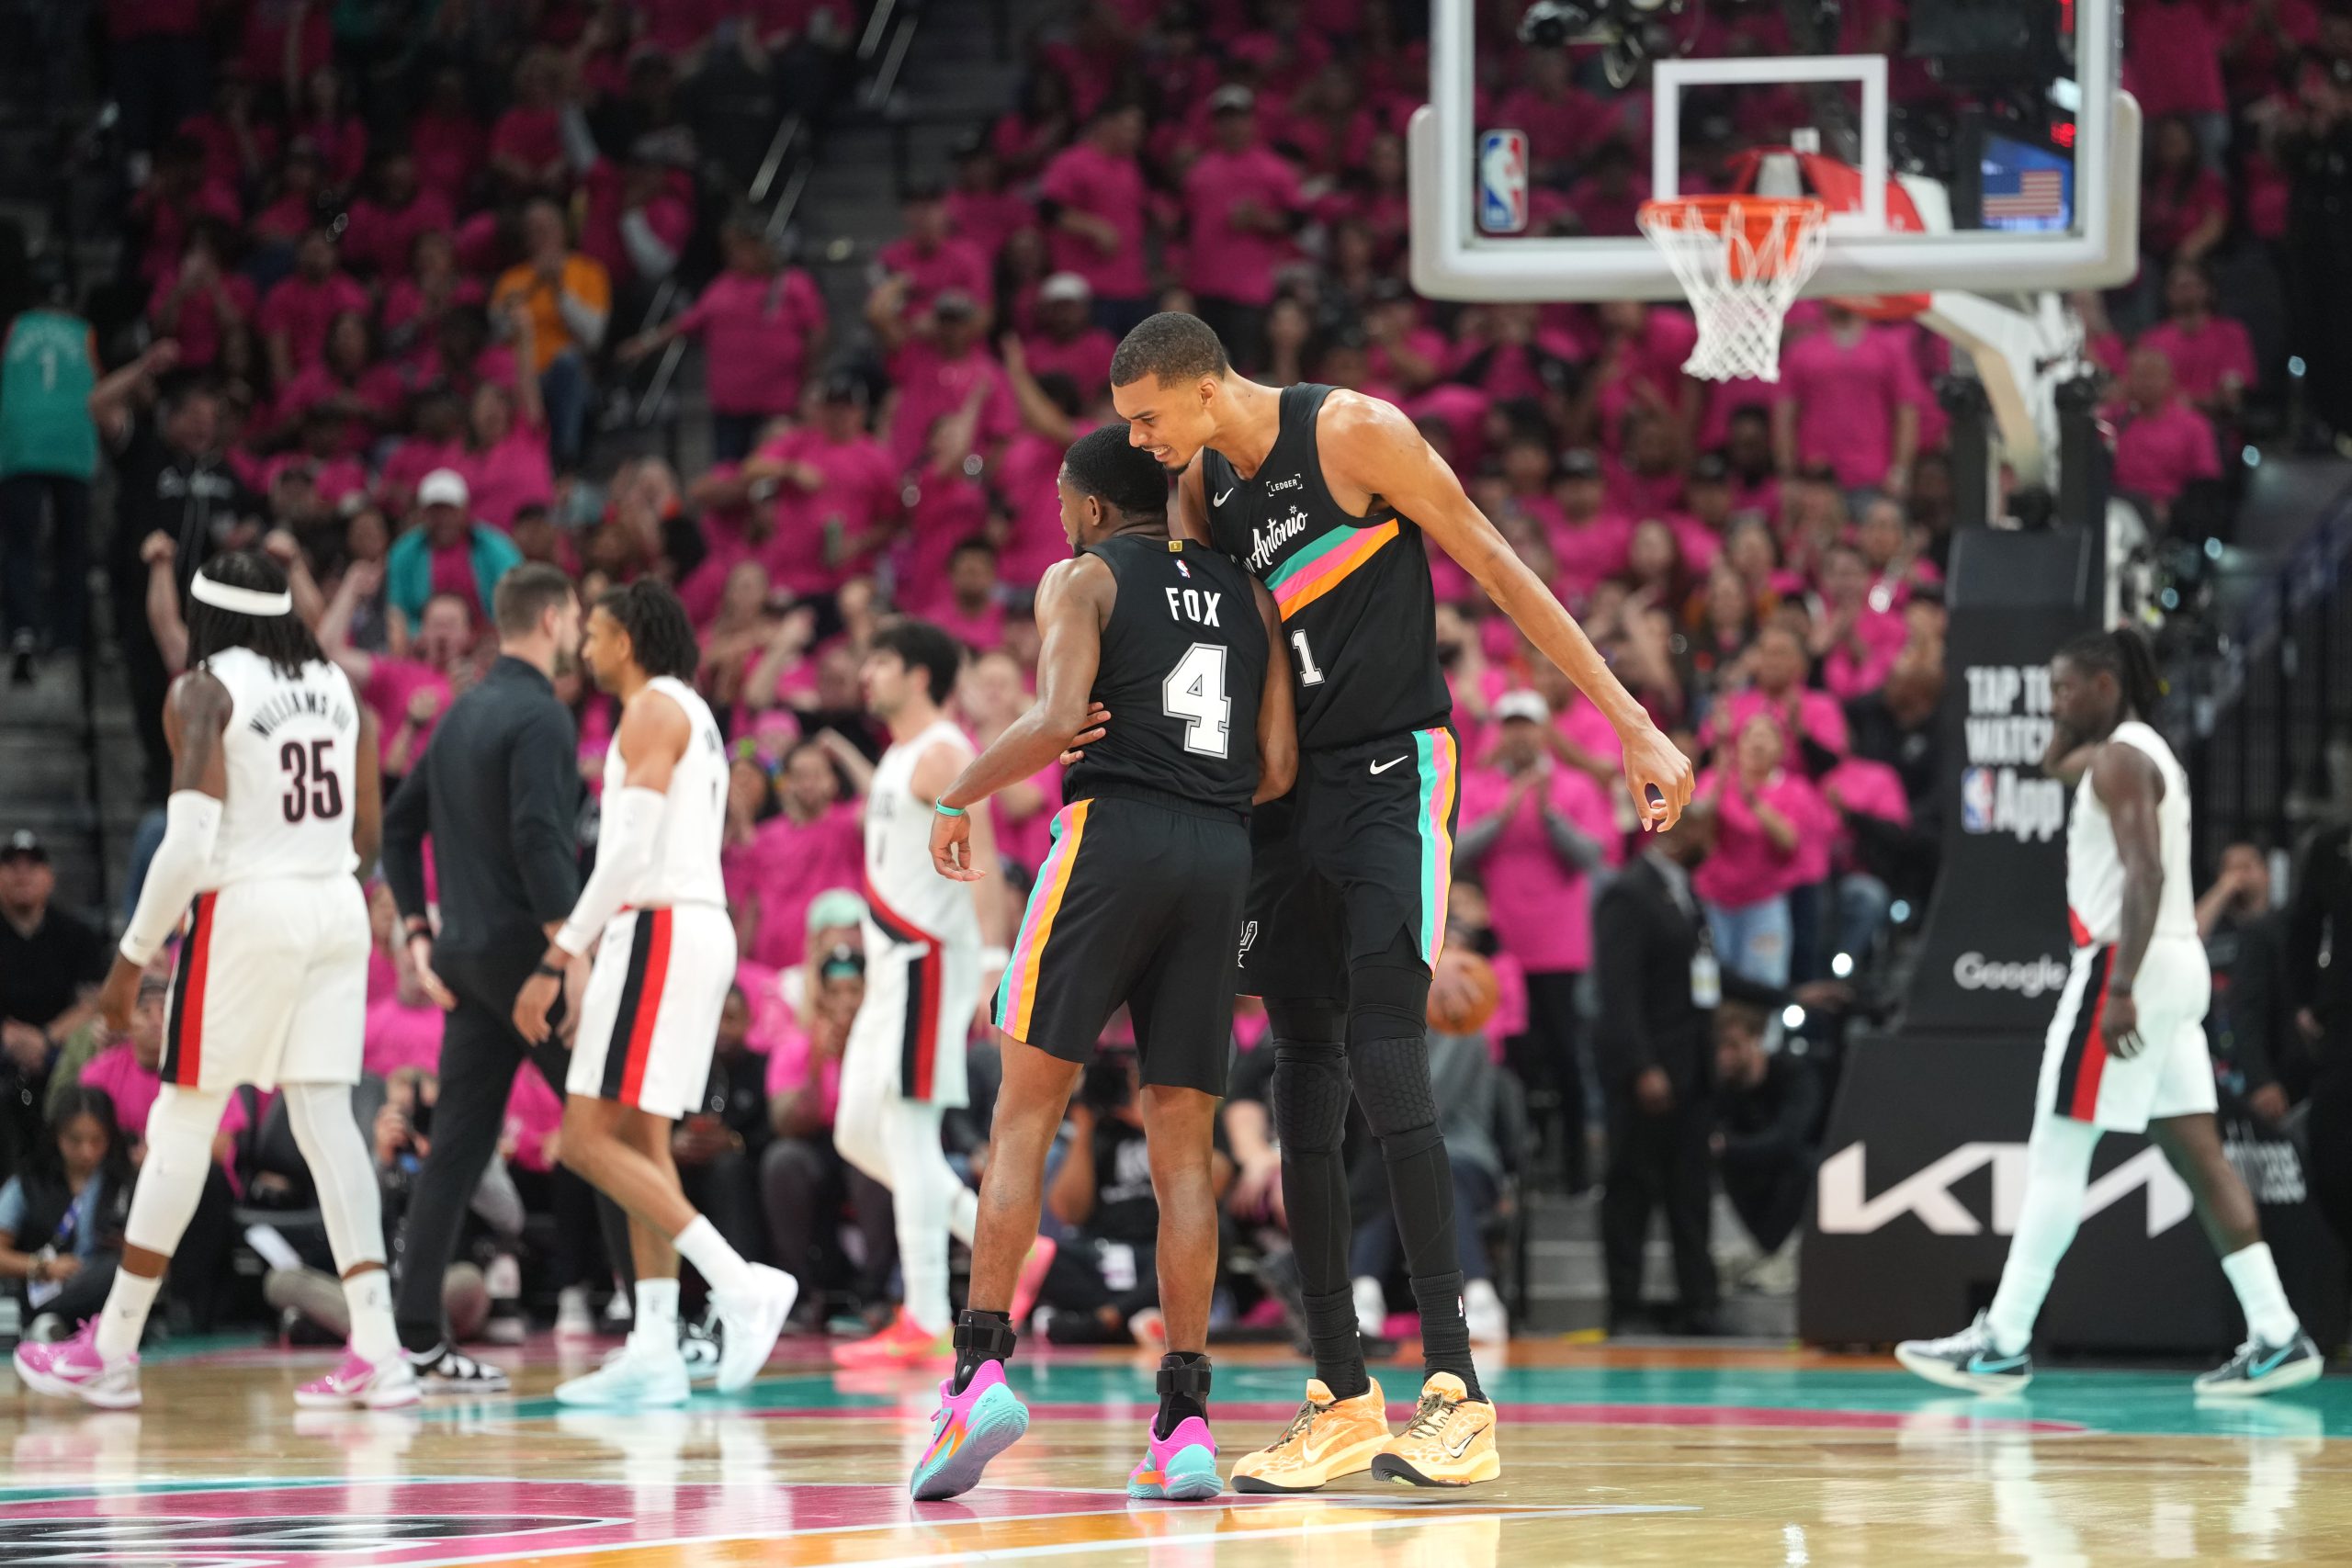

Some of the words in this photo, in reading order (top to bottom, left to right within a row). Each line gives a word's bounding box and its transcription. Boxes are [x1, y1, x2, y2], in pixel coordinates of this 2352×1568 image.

[1270, 479, 1298, 492] LEDGER
[1250, 504, 1308, 570] Antonio
[1165, 587, 1222, 627] FOX
[1291, 628, 1326, 687] 1
[249, 692, 327, 738] WILLIAMS
[1162, 641, 1232, 760] 4
[1964, 665, 2020, 714] TAP
[280, 739, 343, 822] 35
[1995, 768, 2064, 842] App
[1953, 952, 2067, 998] Google
